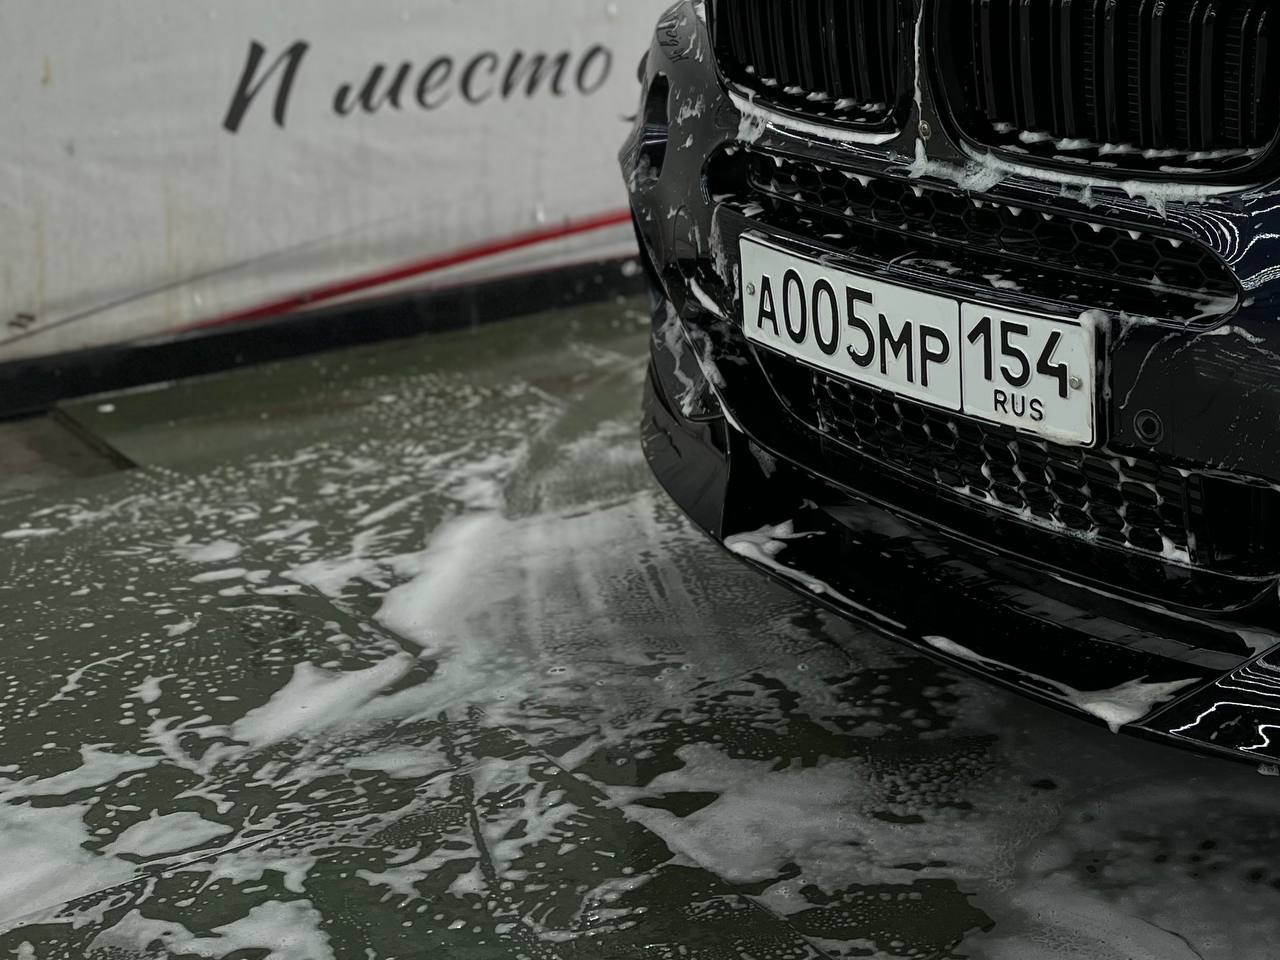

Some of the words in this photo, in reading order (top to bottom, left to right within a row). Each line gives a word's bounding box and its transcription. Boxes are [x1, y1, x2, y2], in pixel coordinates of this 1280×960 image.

[222, 39, 310, 134] И
[332, 43, 613, 118] место
[966, 316, 1071, 399] 154
[993, 388, 1045, 423] RUS
